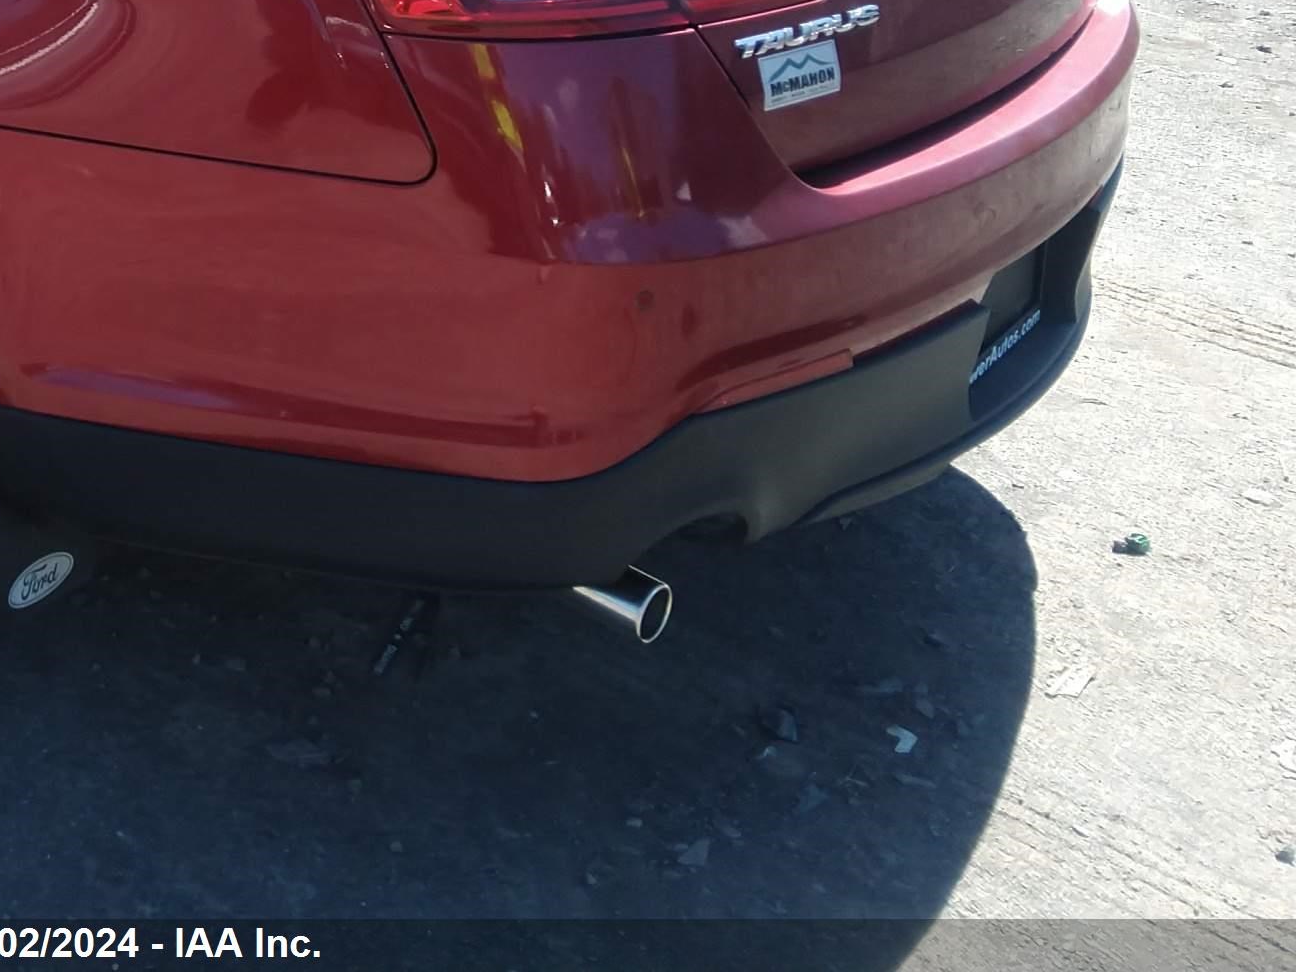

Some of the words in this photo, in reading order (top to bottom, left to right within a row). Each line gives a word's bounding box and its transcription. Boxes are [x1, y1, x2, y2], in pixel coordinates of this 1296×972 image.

[734, 4, 880, 58] TAURUS
[770, 67, 835, 97] McMAHON
[20, 562, 59, 601] Ford
